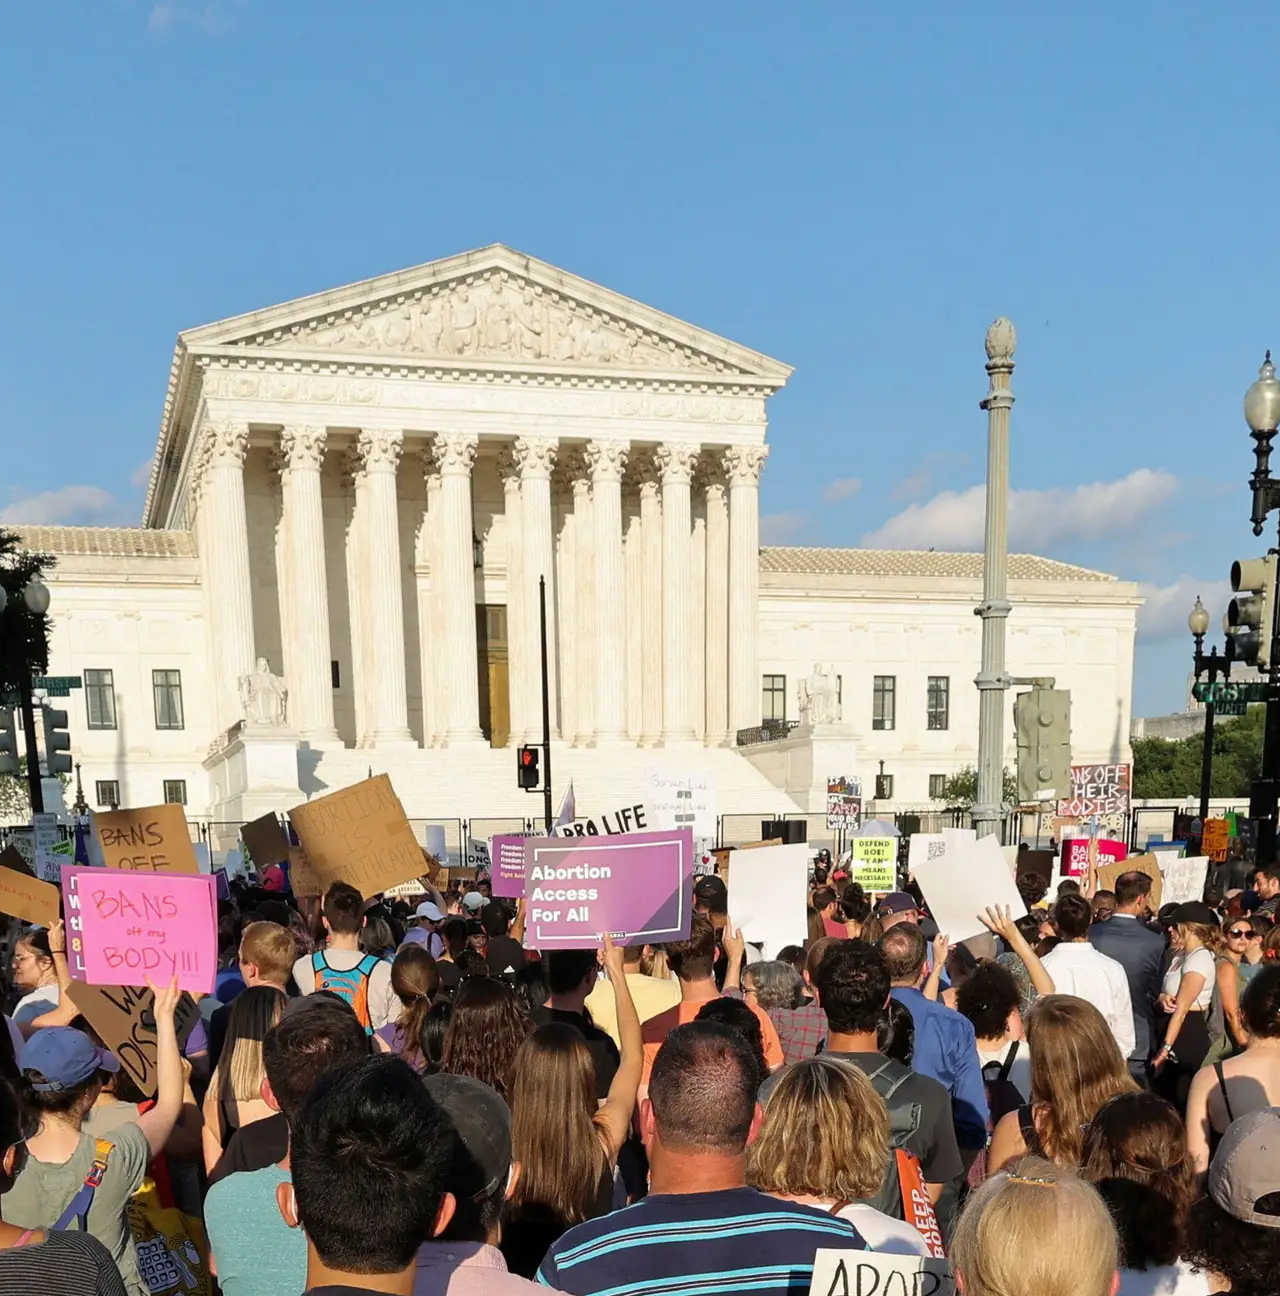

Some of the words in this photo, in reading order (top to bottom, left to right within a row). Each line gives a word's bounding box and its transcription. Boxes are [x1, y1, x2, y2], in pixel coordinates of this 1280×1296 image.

[35, 677, 69, 688] FIRST
[1199, 683, 1249, 701] FIRST
[1215, 703, 1245, 715] UNIT
[1070, 767, 1092, 784] ANS
[1094, 764, 1128, 784] OFF
[1072, 783, 1121, 799] HEIR
[299, 783, 398, 842] ABORTION
[1057, 795, 1128, 816] BODIES
[563, 820, 599, 838] PRO
[601, 804, 647, 836] LIFE
[100, 821, 163, 847] BANS
[340, 825, 373, 854] IS
[118, 854, 171, 872] OFF
[531, 863, 611, 881] Abortion
[531, 887, 598, 902] Access
[91, 889, 178, 922] BANS
[532, 908, 561, 923] For
[566, 906, 589, 922] All
[147, 929, 166, 943] my
[912, 1188, 933, 1245] KEEP
